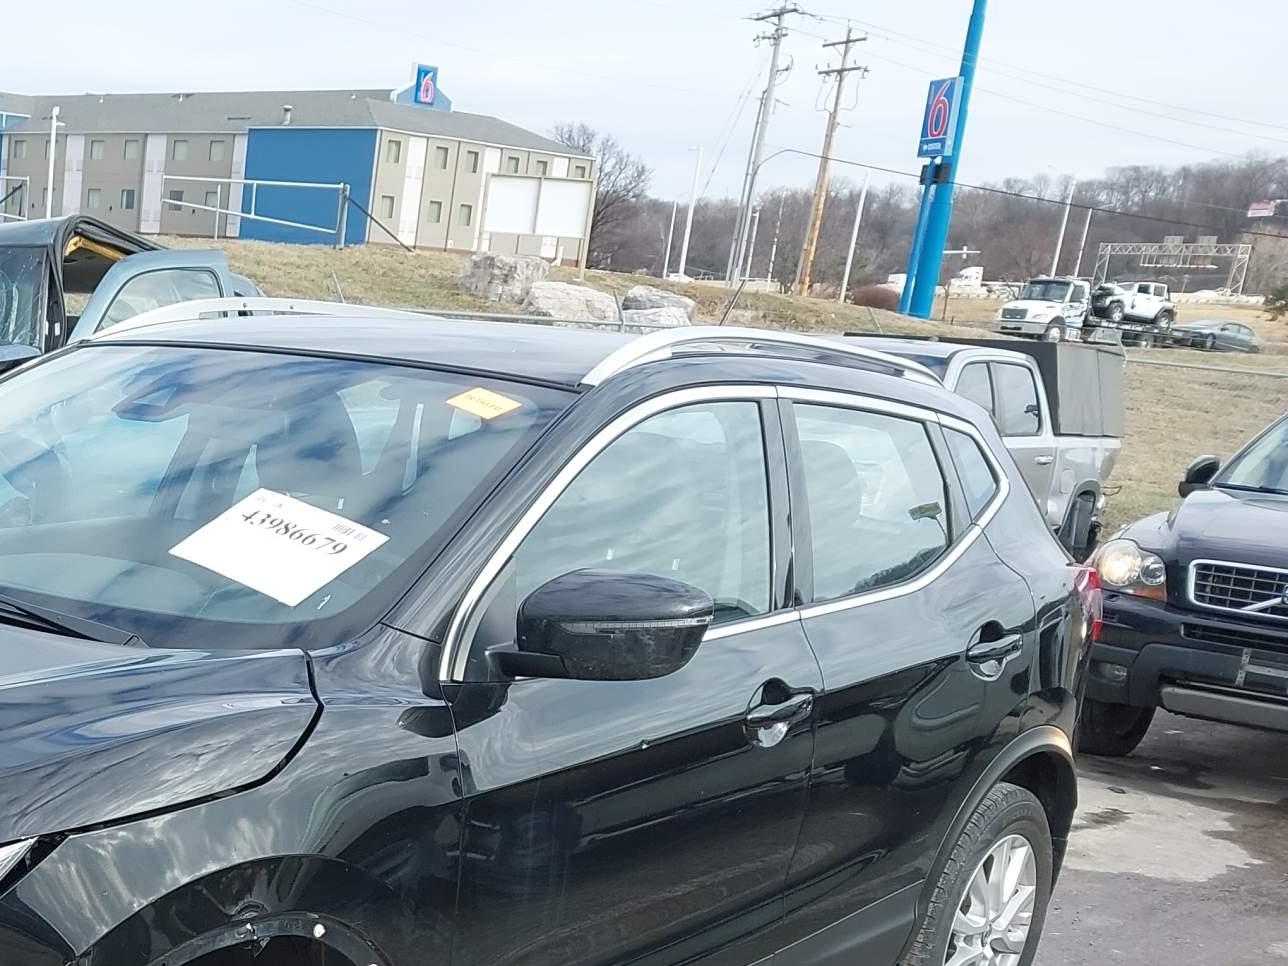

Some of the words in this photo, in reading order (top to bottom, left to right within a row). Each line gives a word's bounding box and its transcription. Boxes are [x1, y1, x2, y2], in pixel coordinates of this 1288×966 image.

[421, 71, 434, 103] 6
[927, 79, 951, 138] 6
[242, 510, 348, 555] 43986679
